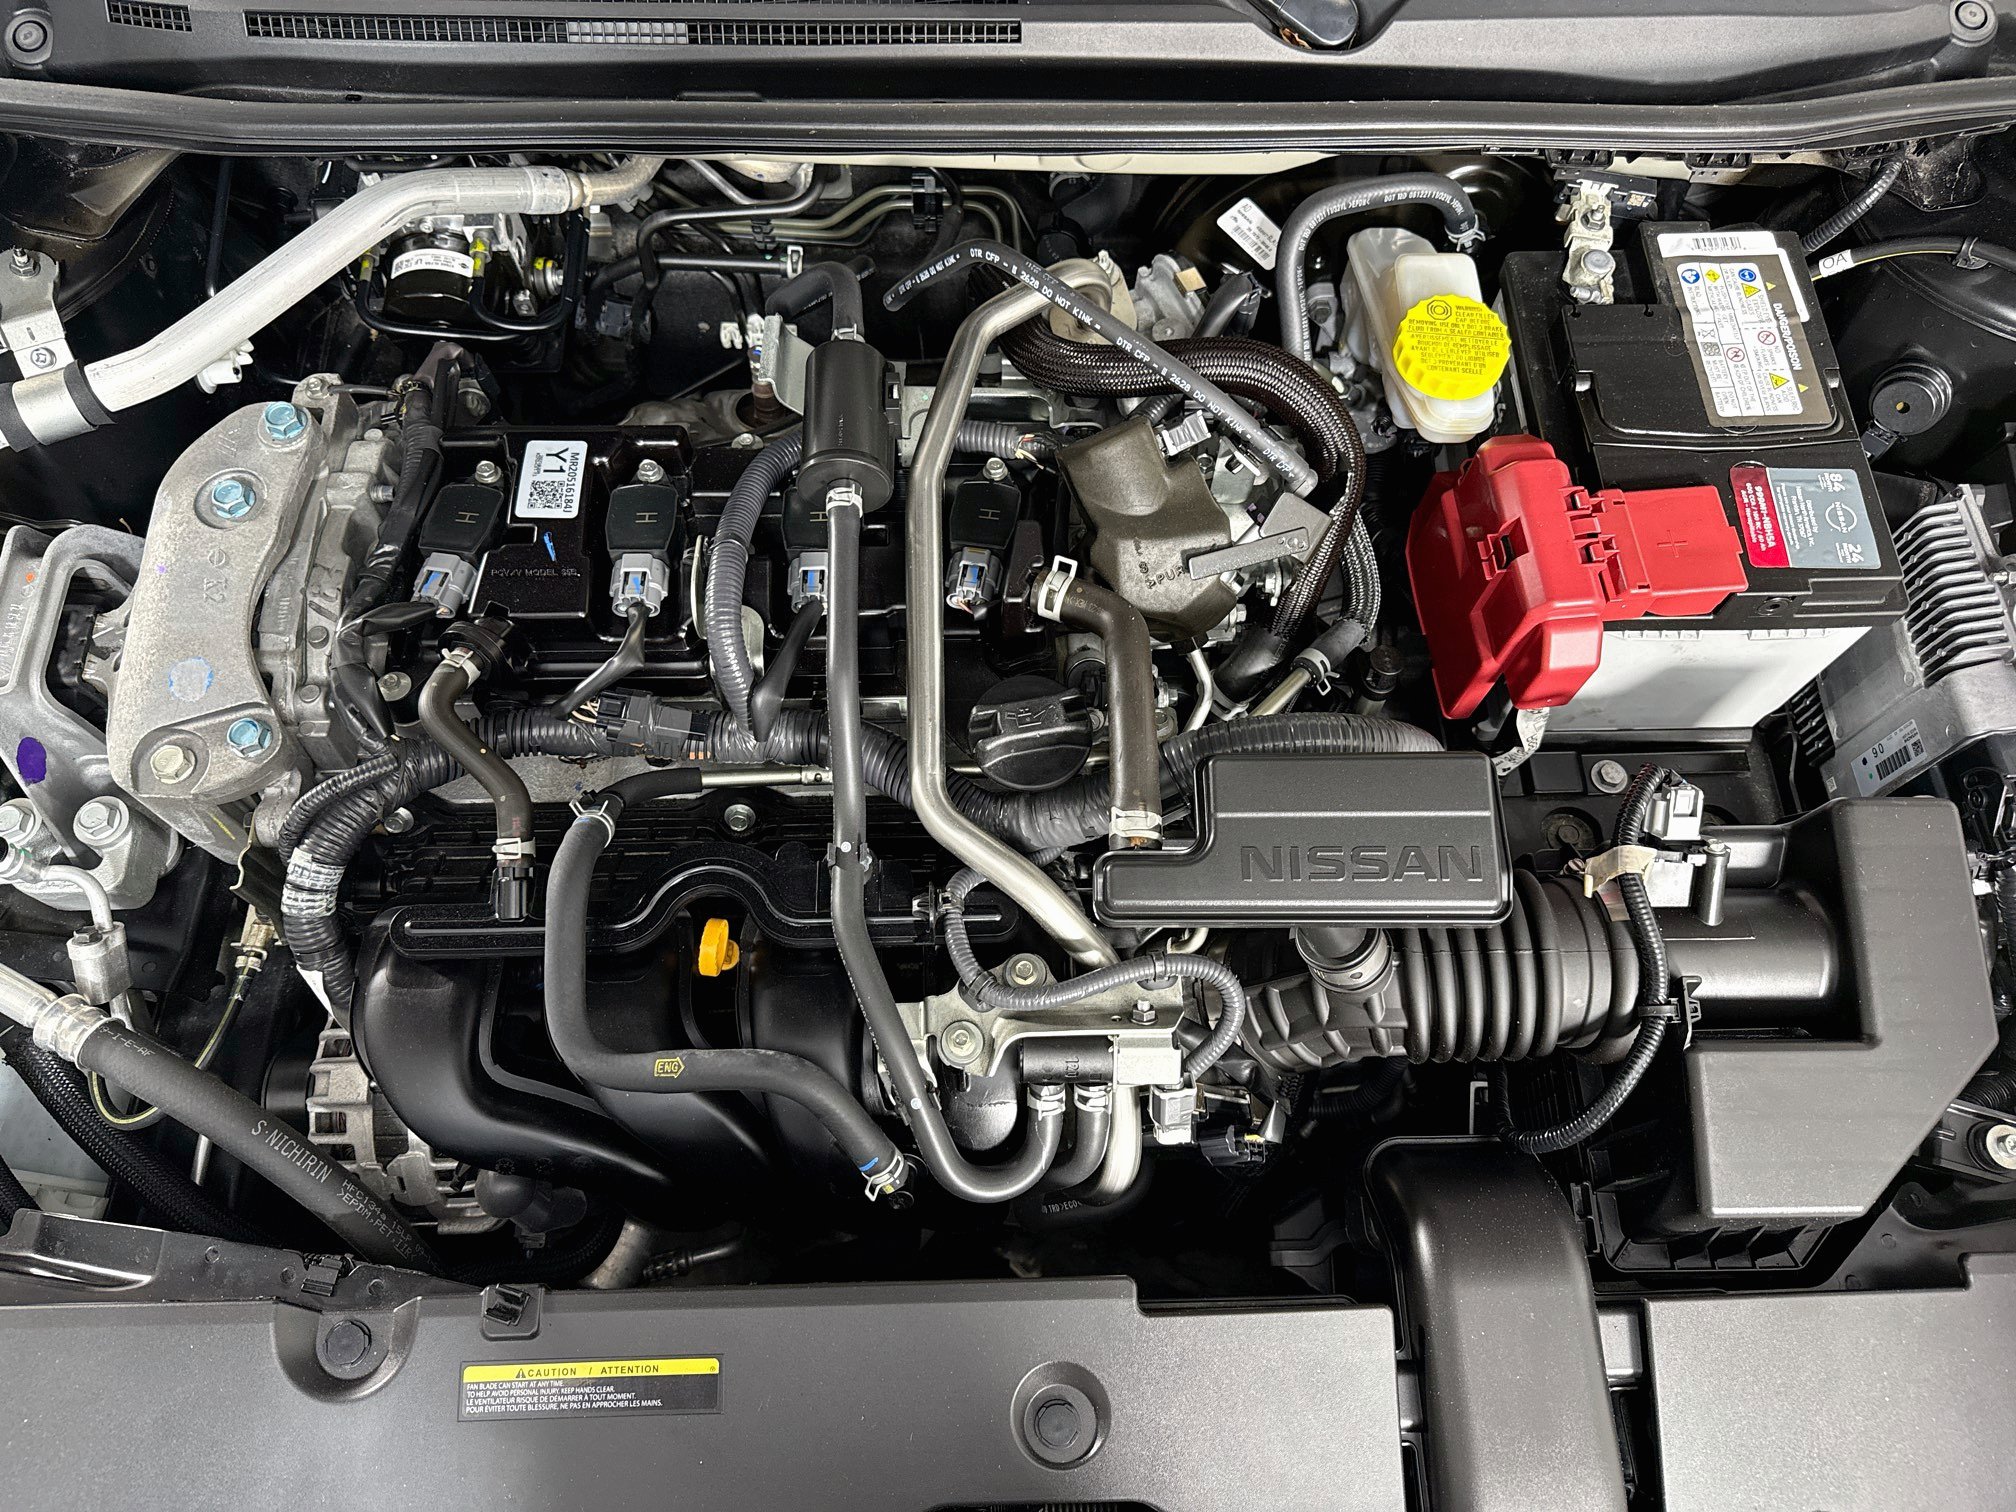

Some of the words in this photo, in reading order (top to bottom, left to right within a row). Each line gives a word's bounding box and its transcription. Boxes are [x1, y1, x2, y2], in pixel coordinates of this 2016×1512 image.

[968, 247, 983, 258] DTR
[983, 250, 1000, 265] CFP
[1040, 285, 1054, 298] DO
[1053, 294, 1071, 310] NOT
[1070, 306, 1094, 325] KINK
[1772, 303, 1802, 370] DANGER/POISON
[1114, 336, 1133, 353] DTR
[1133, 348, 1150, 364] CFP
[1192, 389, 1206, 403] DO
[1206, 400, 1224, 416] NOT
[1223, 414, 1245, 434] KINK
[543, 447, 568, 473] Y1
[1262, 447, 1278, 462] DTR
[562, 452, 579, 512] MR20516184J
[1828, 473, 1845, 491] 84
[1740, 489, 1748, 503] AGM
[1748, 494, 1756, 506] CCA
[1754, 521, 1762, 530] RC
[1834, 502, 1847, 532] NISSAN
[1847, 543, 1864, 562] 24
[1240, 845, 1483, 881] NISSAN
[657, 1062, 678, 1072] ENG
[341, 1179, 389, 1220] HFC134a
[527, 1368, 576, 1377] CAUTION
[600, 1364, 659, 1375] ATTENTION
[474, 1397, 515, 1405] VENTILATEUR
[527, 1403, 559, 1411] BLESSURE,
[591, 1400, 628, 1408] APPROCHER
